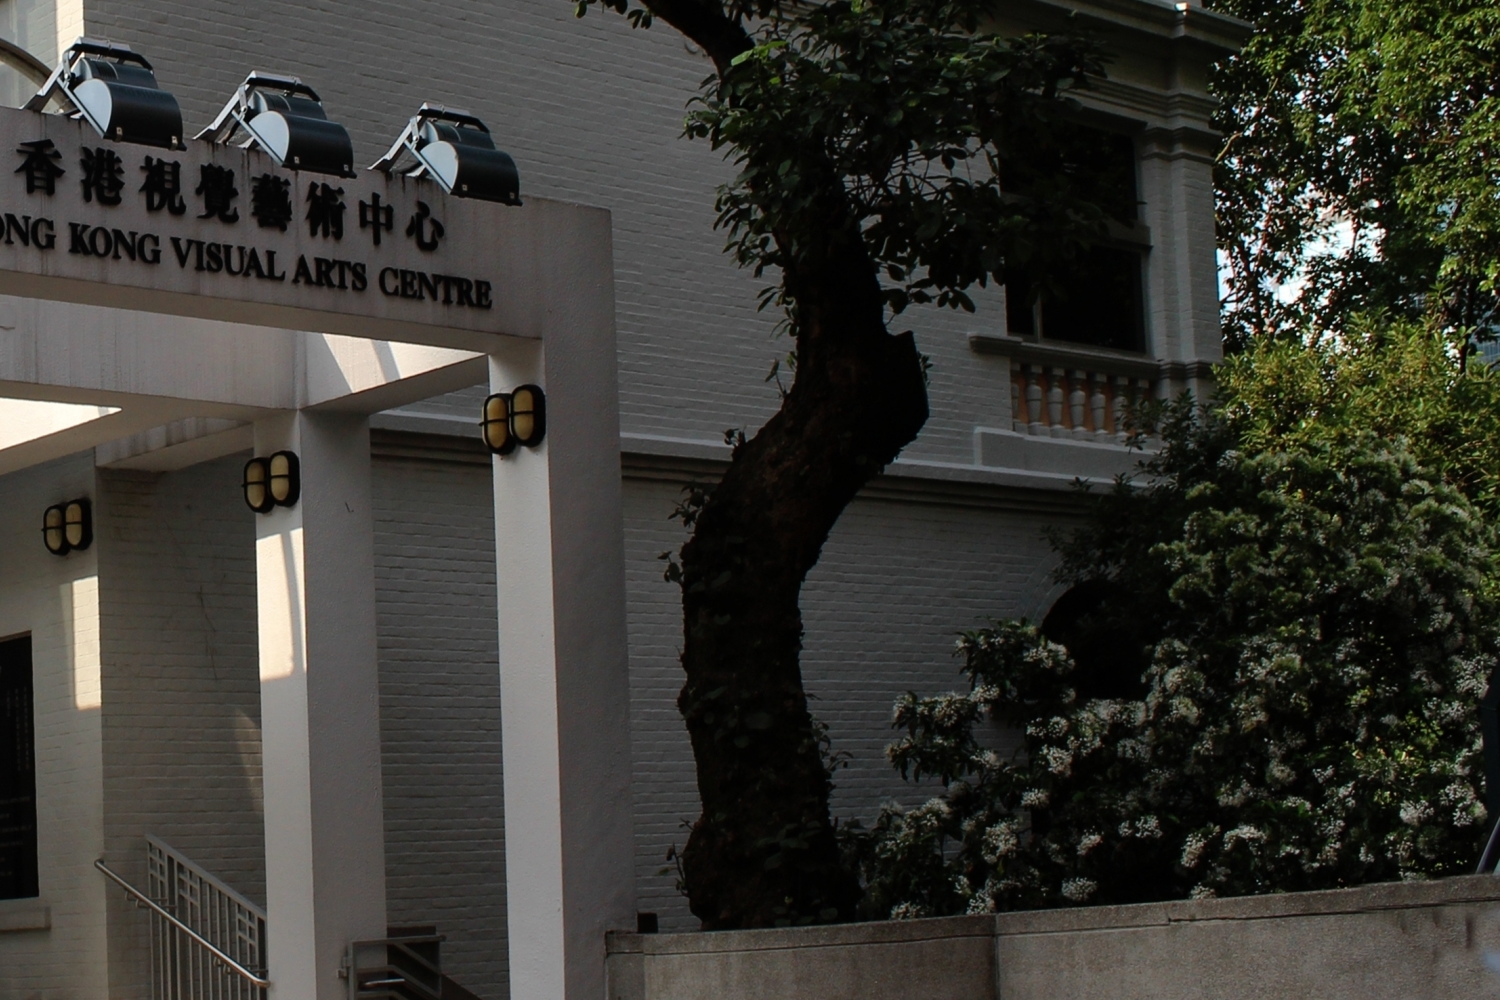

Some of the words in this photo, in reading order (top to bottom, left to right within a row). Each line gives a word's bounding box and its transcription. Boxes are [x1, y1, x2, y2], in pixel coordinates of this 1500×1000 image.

[14, 139, 446, 253] 香港視覺藝術中心
[68, 221, 161, 265] KONG
[170, 236, 286, 282] VISUAL
[292, 254, 367, 291] ARTS
[378, 266, 492, 310] CENTRE
